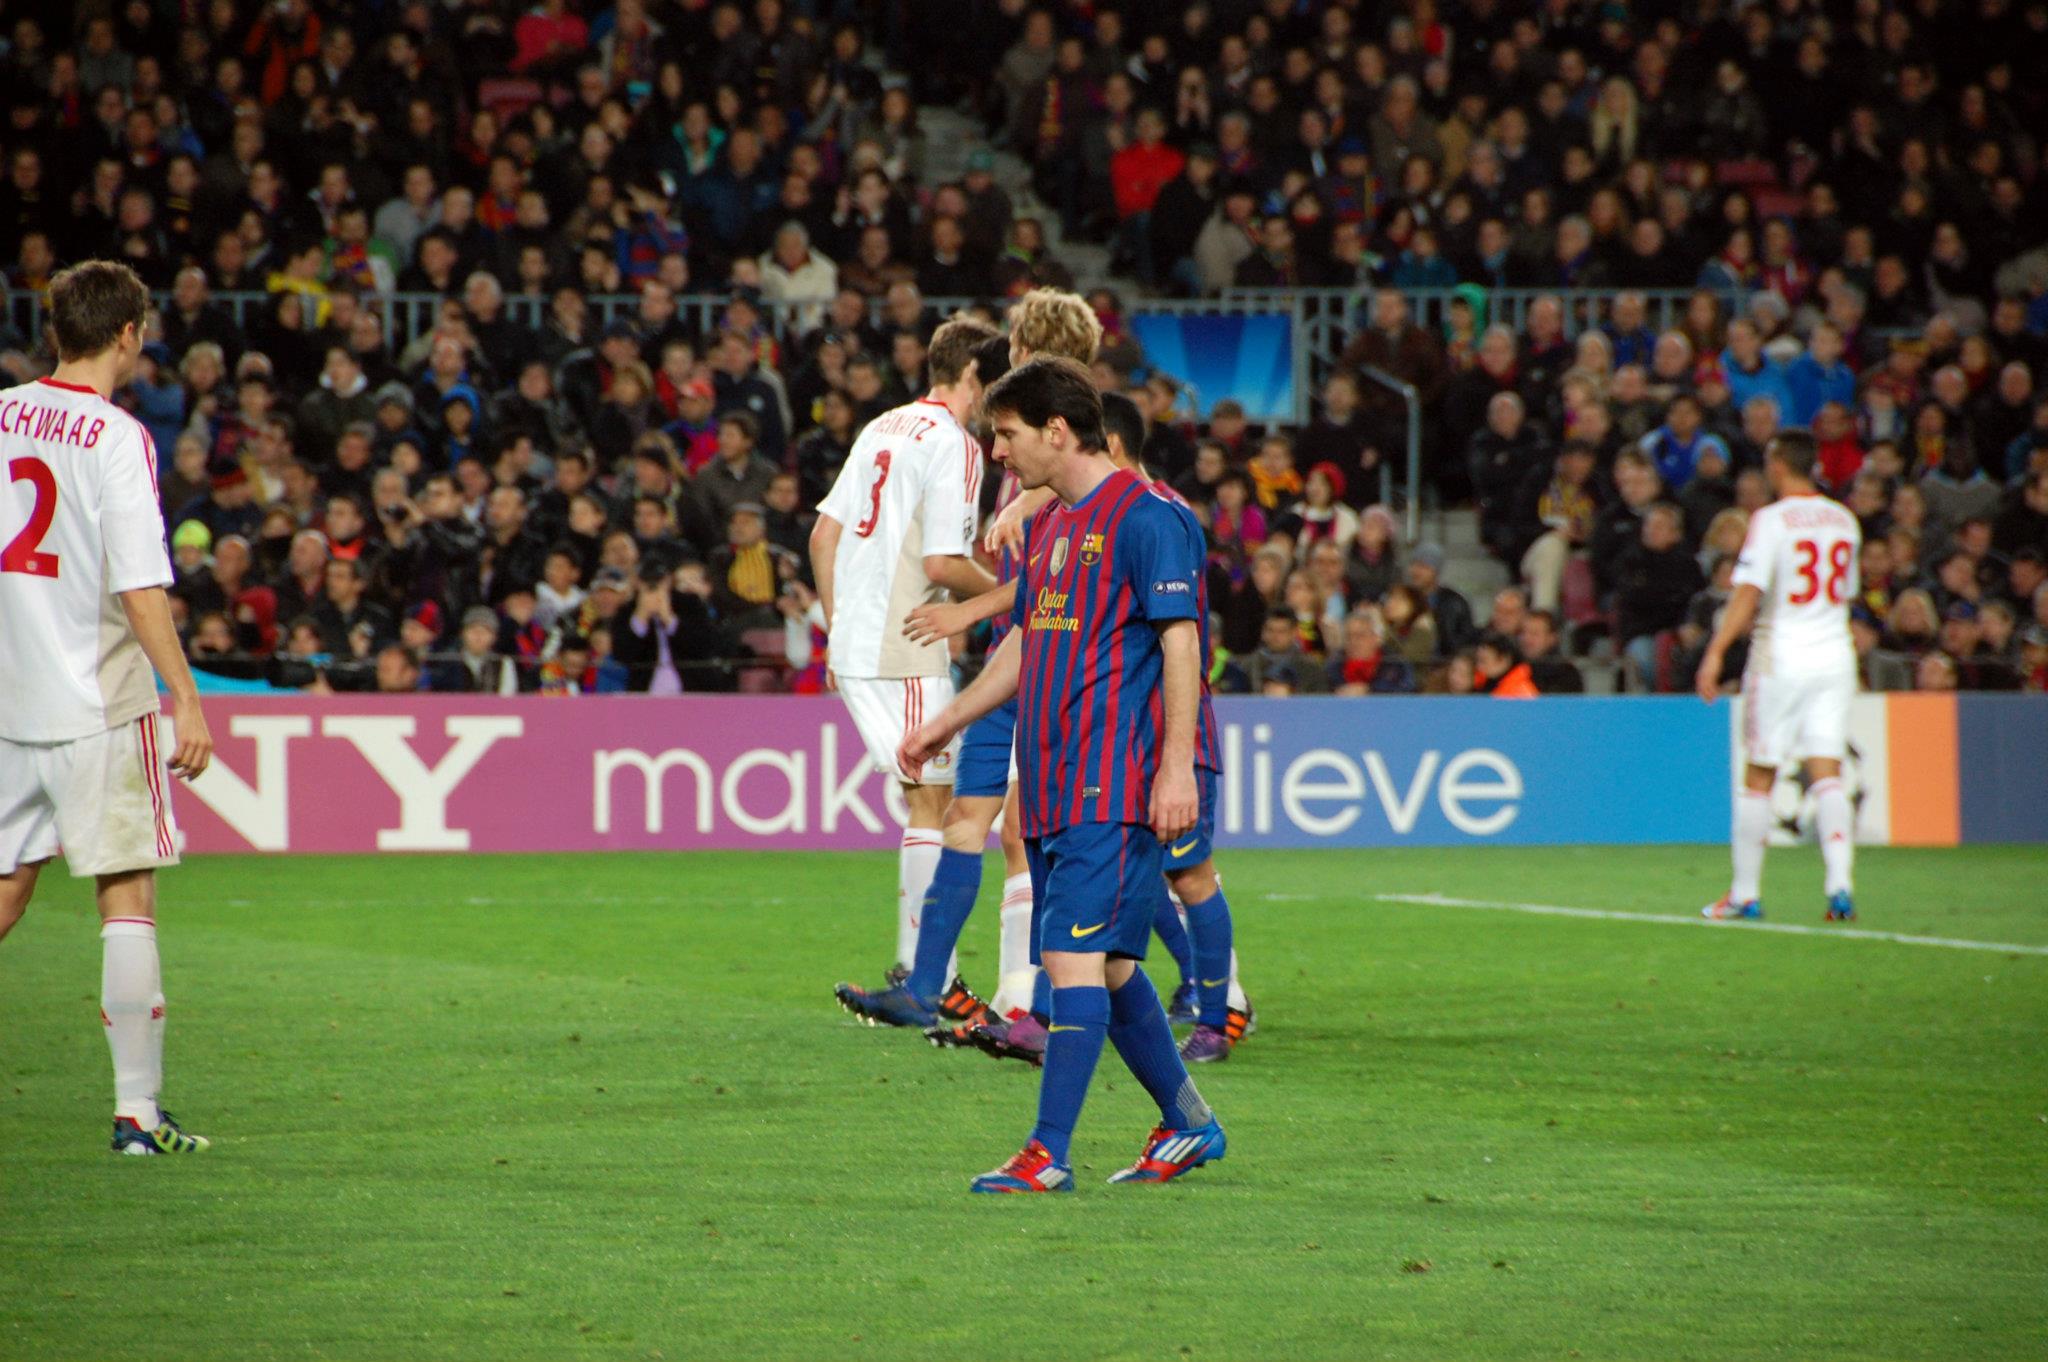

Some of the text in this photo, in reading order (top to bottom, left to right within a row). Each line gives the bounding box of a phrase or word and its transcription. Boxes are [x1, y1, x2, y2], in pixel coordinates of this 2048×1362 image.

[0, 400, 105, 448] CHWAAB
[0, 457, 58, 578] 2
[854, 449, 891, 538] 3
[1788, 539, 1853, 605] 38
[161, 716, 523, 850] NY
[1224, 724, 1523, 835] lieve
